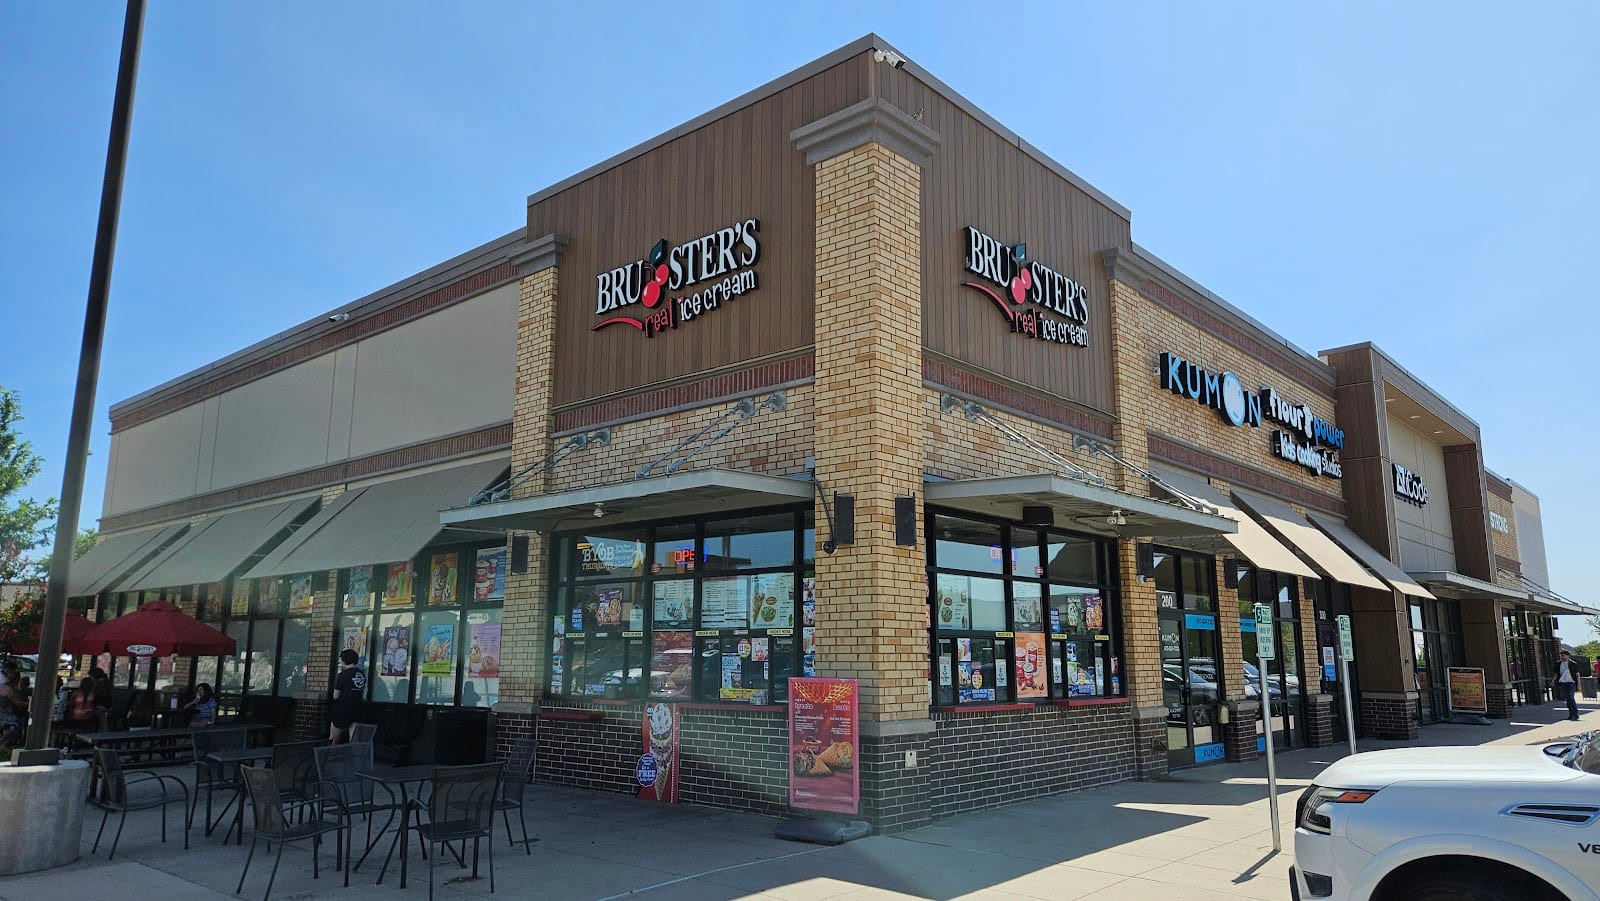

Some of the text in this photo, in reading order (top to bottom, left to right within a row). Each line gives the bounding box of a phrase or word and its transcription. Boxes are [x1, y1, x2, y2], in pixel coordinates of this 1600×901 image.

[596, 218, 760, 314] BRUSTER'S
[967, 226, 1089, 325] BRUSTER'S
[644, 269, 758, 338] real ice cream
[1014, 308, 1089, 347] real ice cream
[1163, 352, 1262, 428] KUMON
[1269, 388, 1345, 449] flour power
[1280, 431, 1342, 479] kids cooking studios
[674, 550, 695, 562] OPE
[1161, 594, 1173, 608] 200
[1161, 633, 1180, 643] KUMON
[1203, 745, 1224, 758] KUMON
[638, 769, 656, 778] FREE
